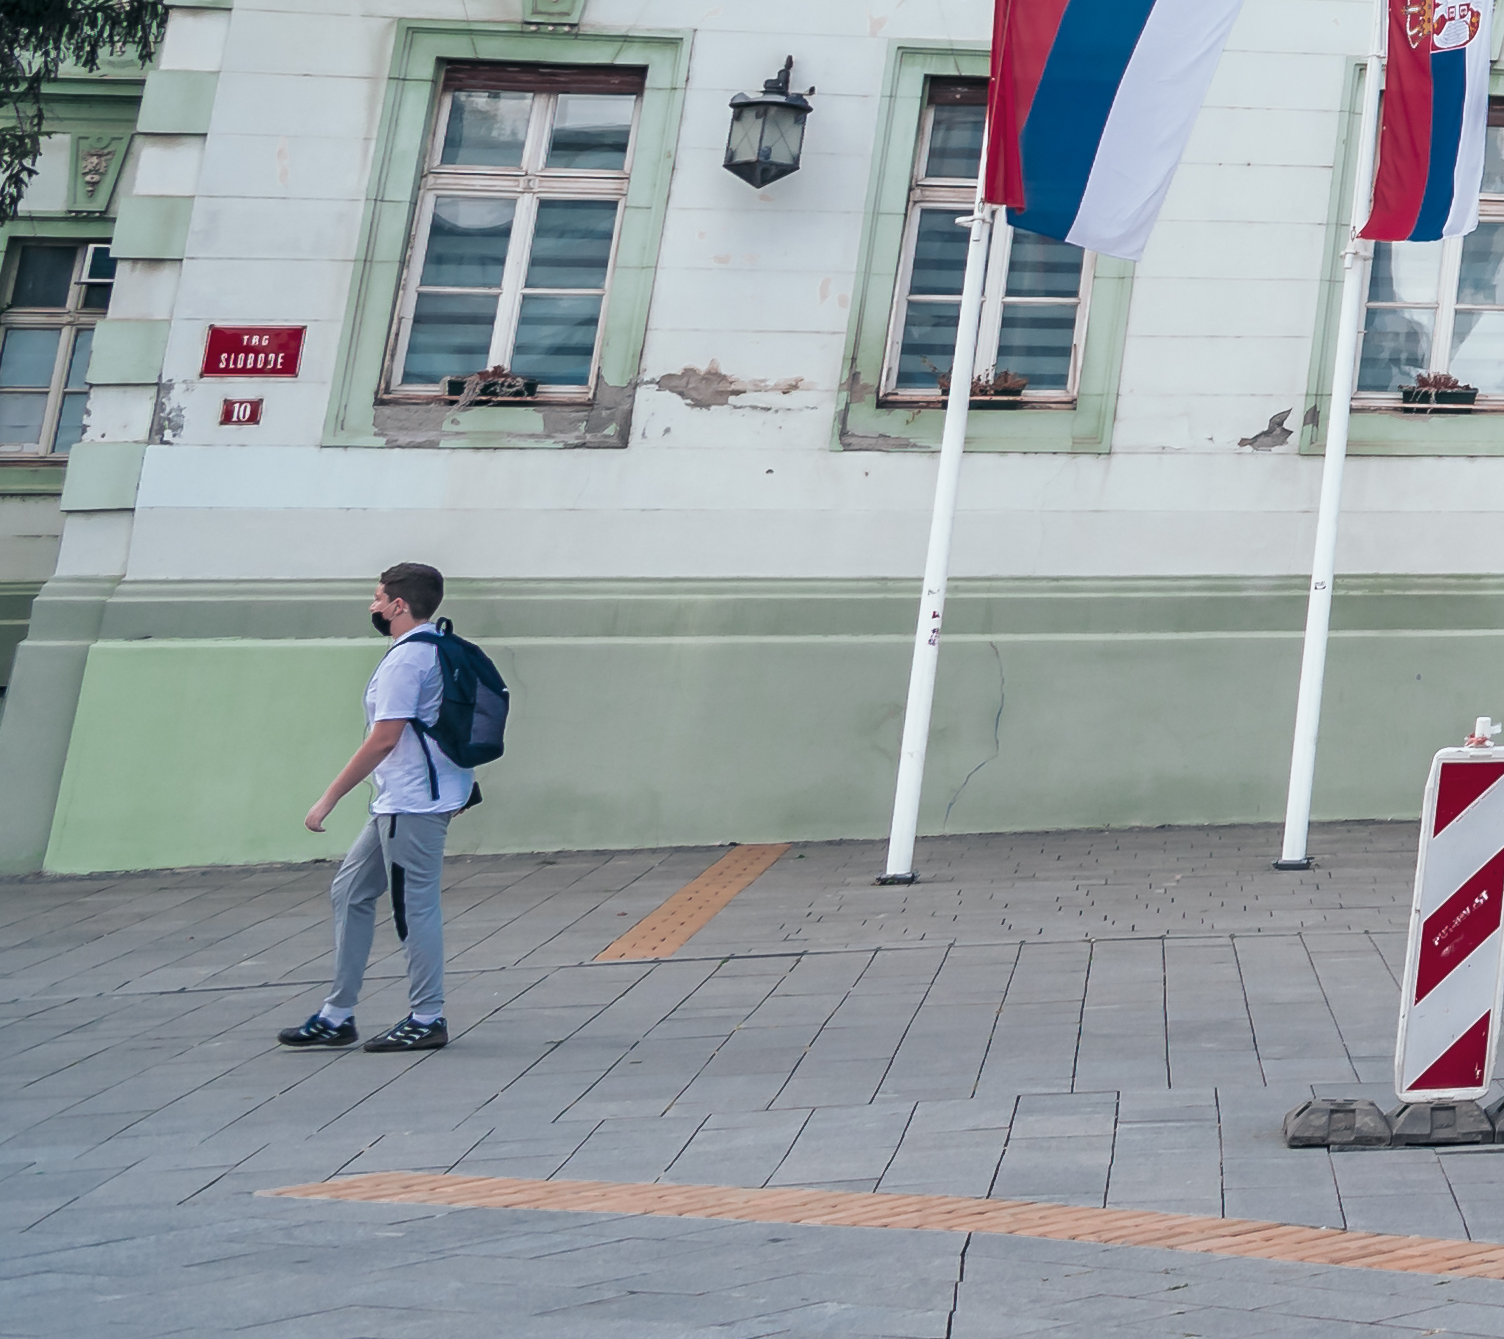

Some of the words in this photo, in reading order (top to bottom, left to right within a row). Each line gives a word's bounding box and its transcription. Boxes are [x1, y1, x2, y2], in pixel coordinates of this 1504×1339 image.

[242, 335, 269, 346] TRG
[219, 353, 285, 369] SLOBODE
[231, 403, 251, 421] 10
